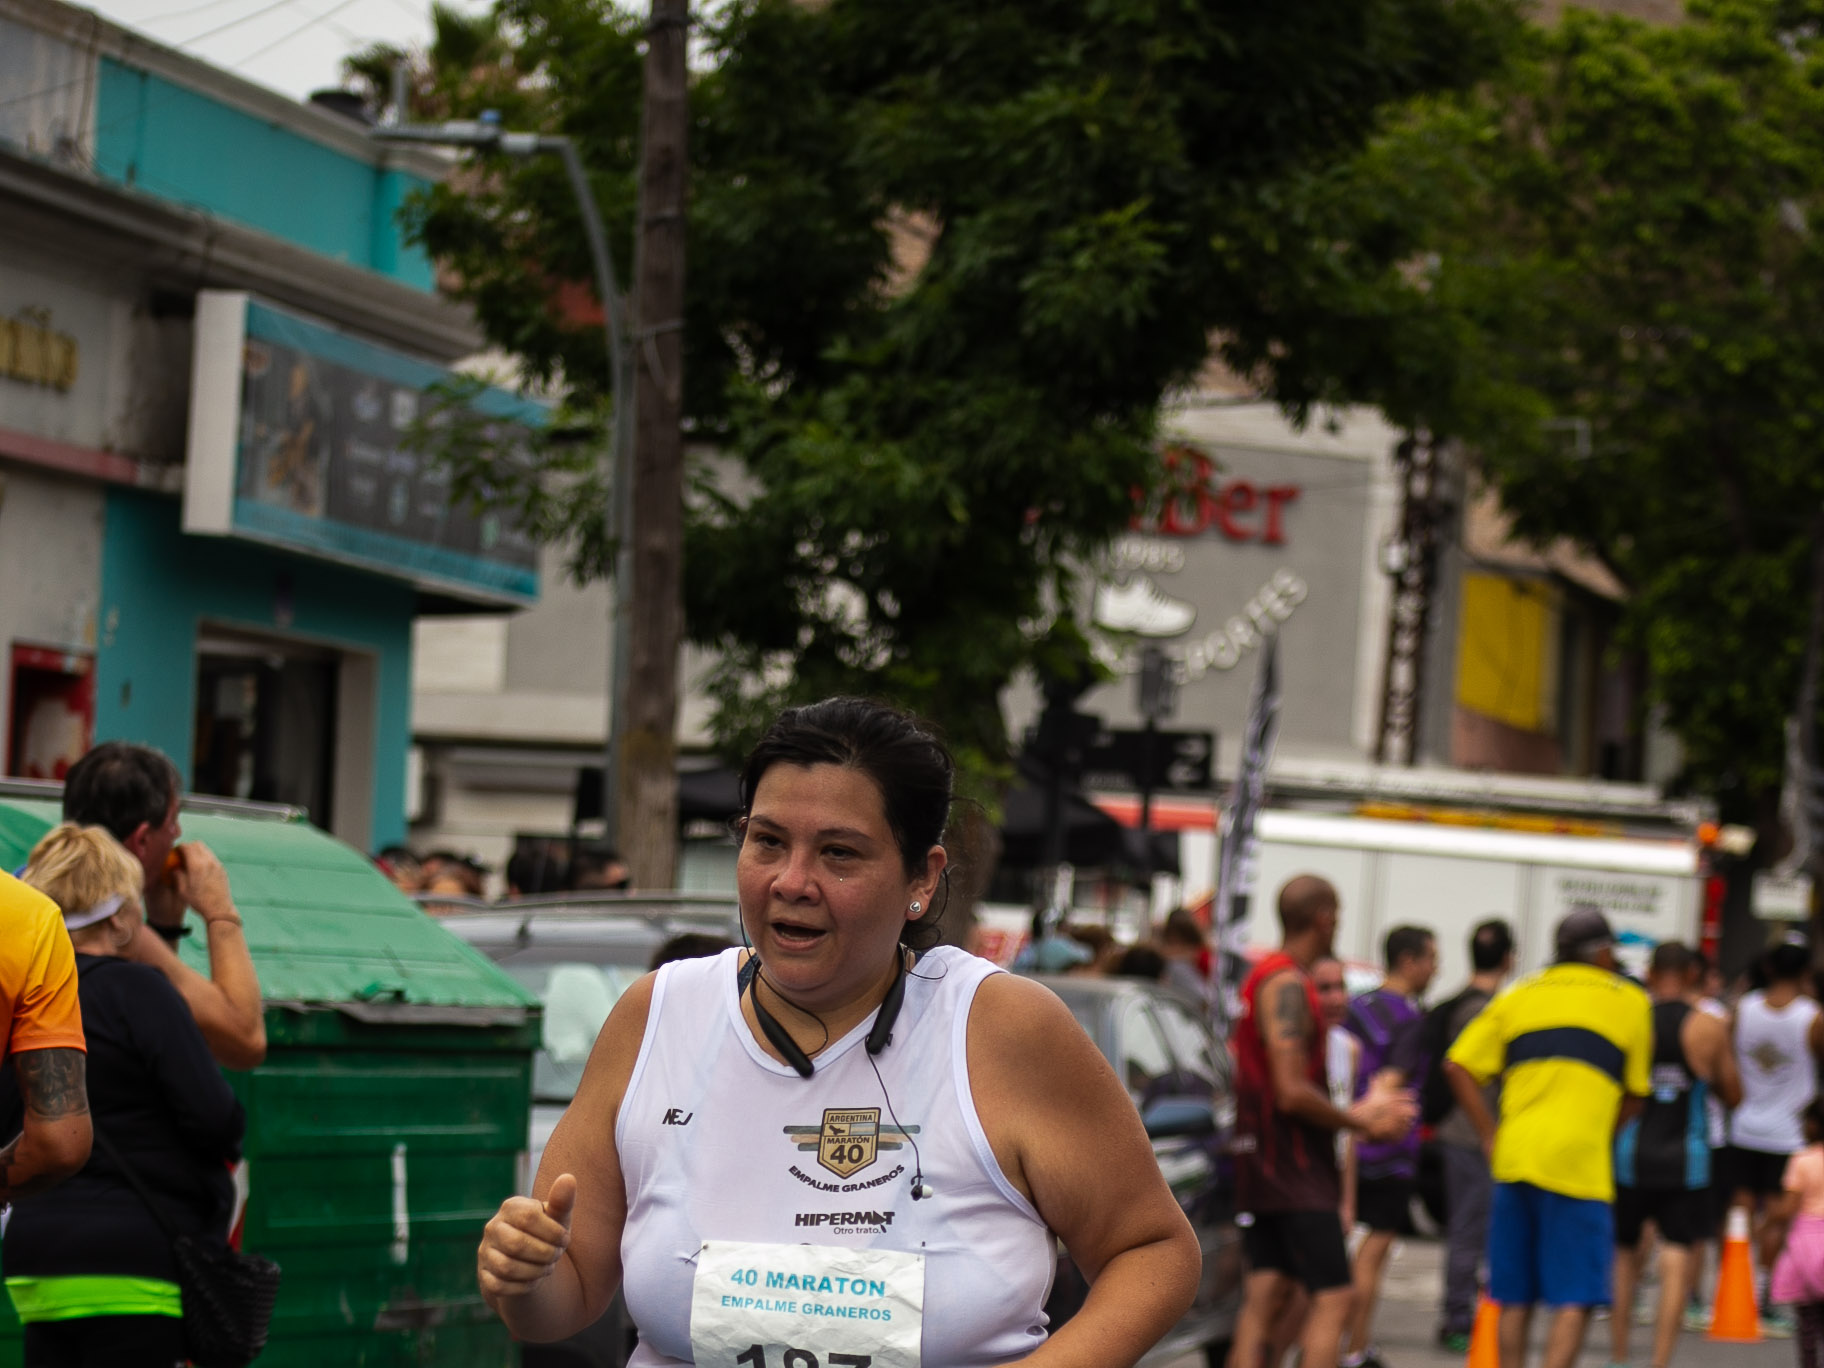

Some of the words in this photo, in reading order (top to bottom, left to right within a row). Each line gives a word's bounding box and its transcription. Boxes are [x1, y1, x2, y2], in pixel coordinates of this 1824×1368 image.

[662, 1108, 693, 1125] NEJ
[829, 1114, 873, 1123] ARGENTINA
[826, 1136, 870, 1144] MARATÓN
[830, 1144, 864, 1164] 40
[788, 1165, 840, 1192] EMPALME
[842, 1164, 905, 1192] GRANEROS
[833, 1226, 854, 1235] Otro
[731, 1269, 758, 1286] 40
[766, 1271, 885, 1297] MARATON
[721, 1295, 797, 1313] EMPALME
[802, 1303, 892, 1321] GRANEROS
